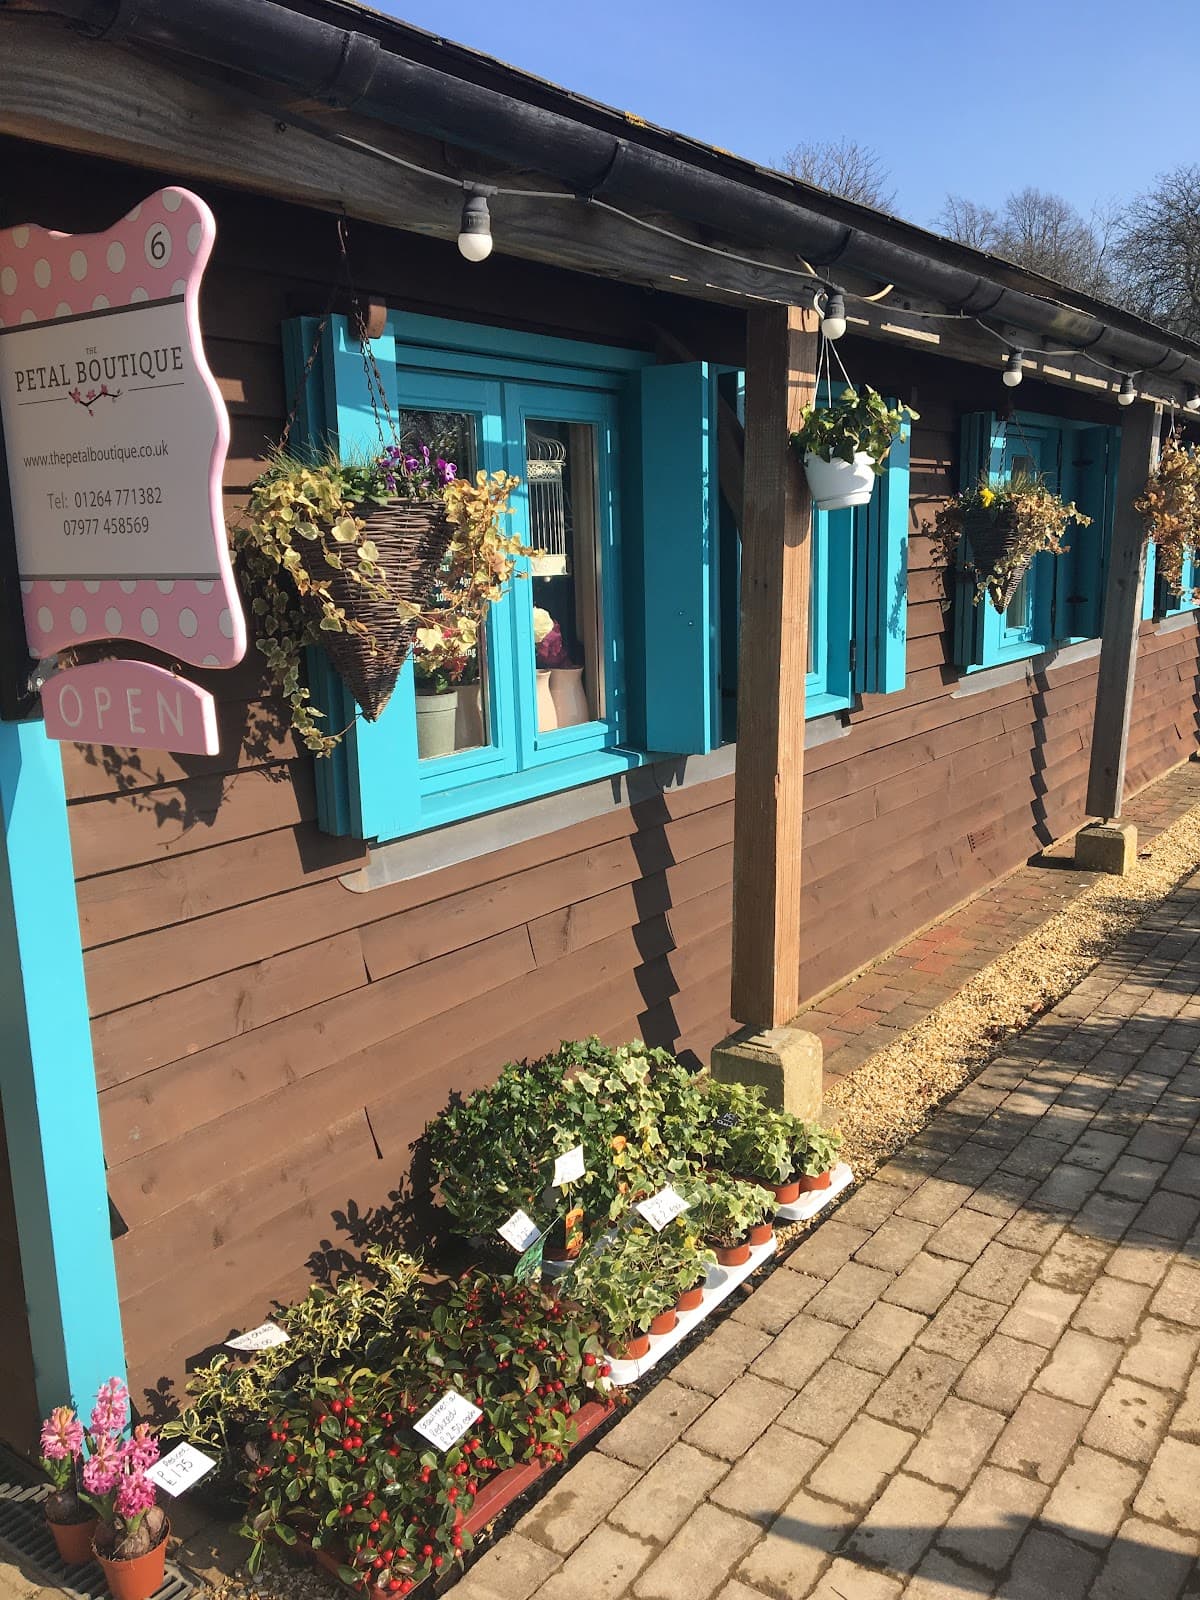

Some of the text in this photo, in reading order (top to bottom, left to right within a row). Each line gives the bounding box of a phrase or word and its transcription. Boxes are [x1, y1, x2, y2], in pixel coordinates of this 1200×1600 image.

[151, 231, 166, 260] 6
[86, 347, 97, 355] THE
[14, 346, 183, 393] PETAL BOUTIQUE
[23, 439, 169, 468] www.thepetalboutique.co.uk
[47, 486, 163, 510] Tel: 01264 771382
[63, 516, 149, 536] 07977 458569
[59, 684, 184, 737] OPEN
